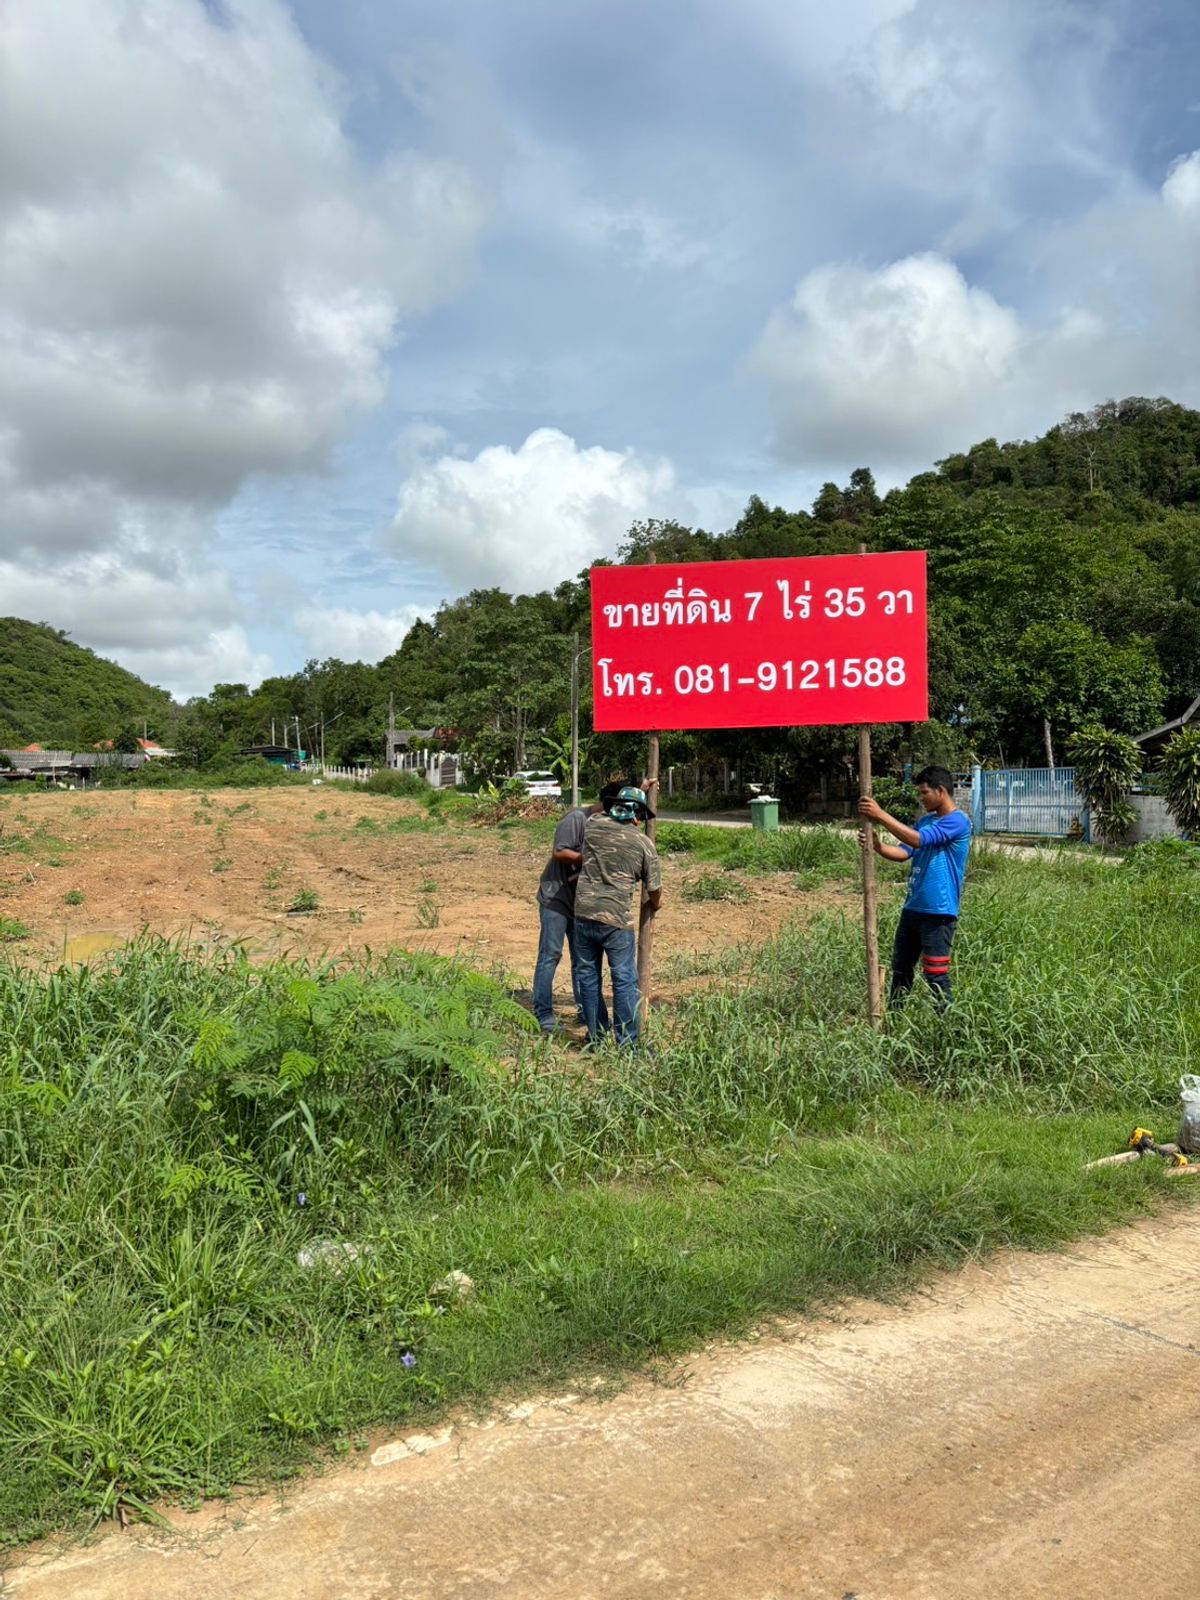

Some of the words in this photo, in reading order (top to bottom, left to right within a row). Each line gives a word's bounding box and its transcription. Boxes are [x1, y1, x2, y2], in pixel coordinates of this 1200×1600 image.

[603, 577, 732, 628] ขายที่ดิน
[744, 591, 763, 621] 7
[777, 579, 812, 620] ไร่
[824, 587, 866, 618] 35
[877, 589, 914, 616] วา
[597, 657, 662, 697] โทร.
[674, 656, 906, 695] 081-9121588
